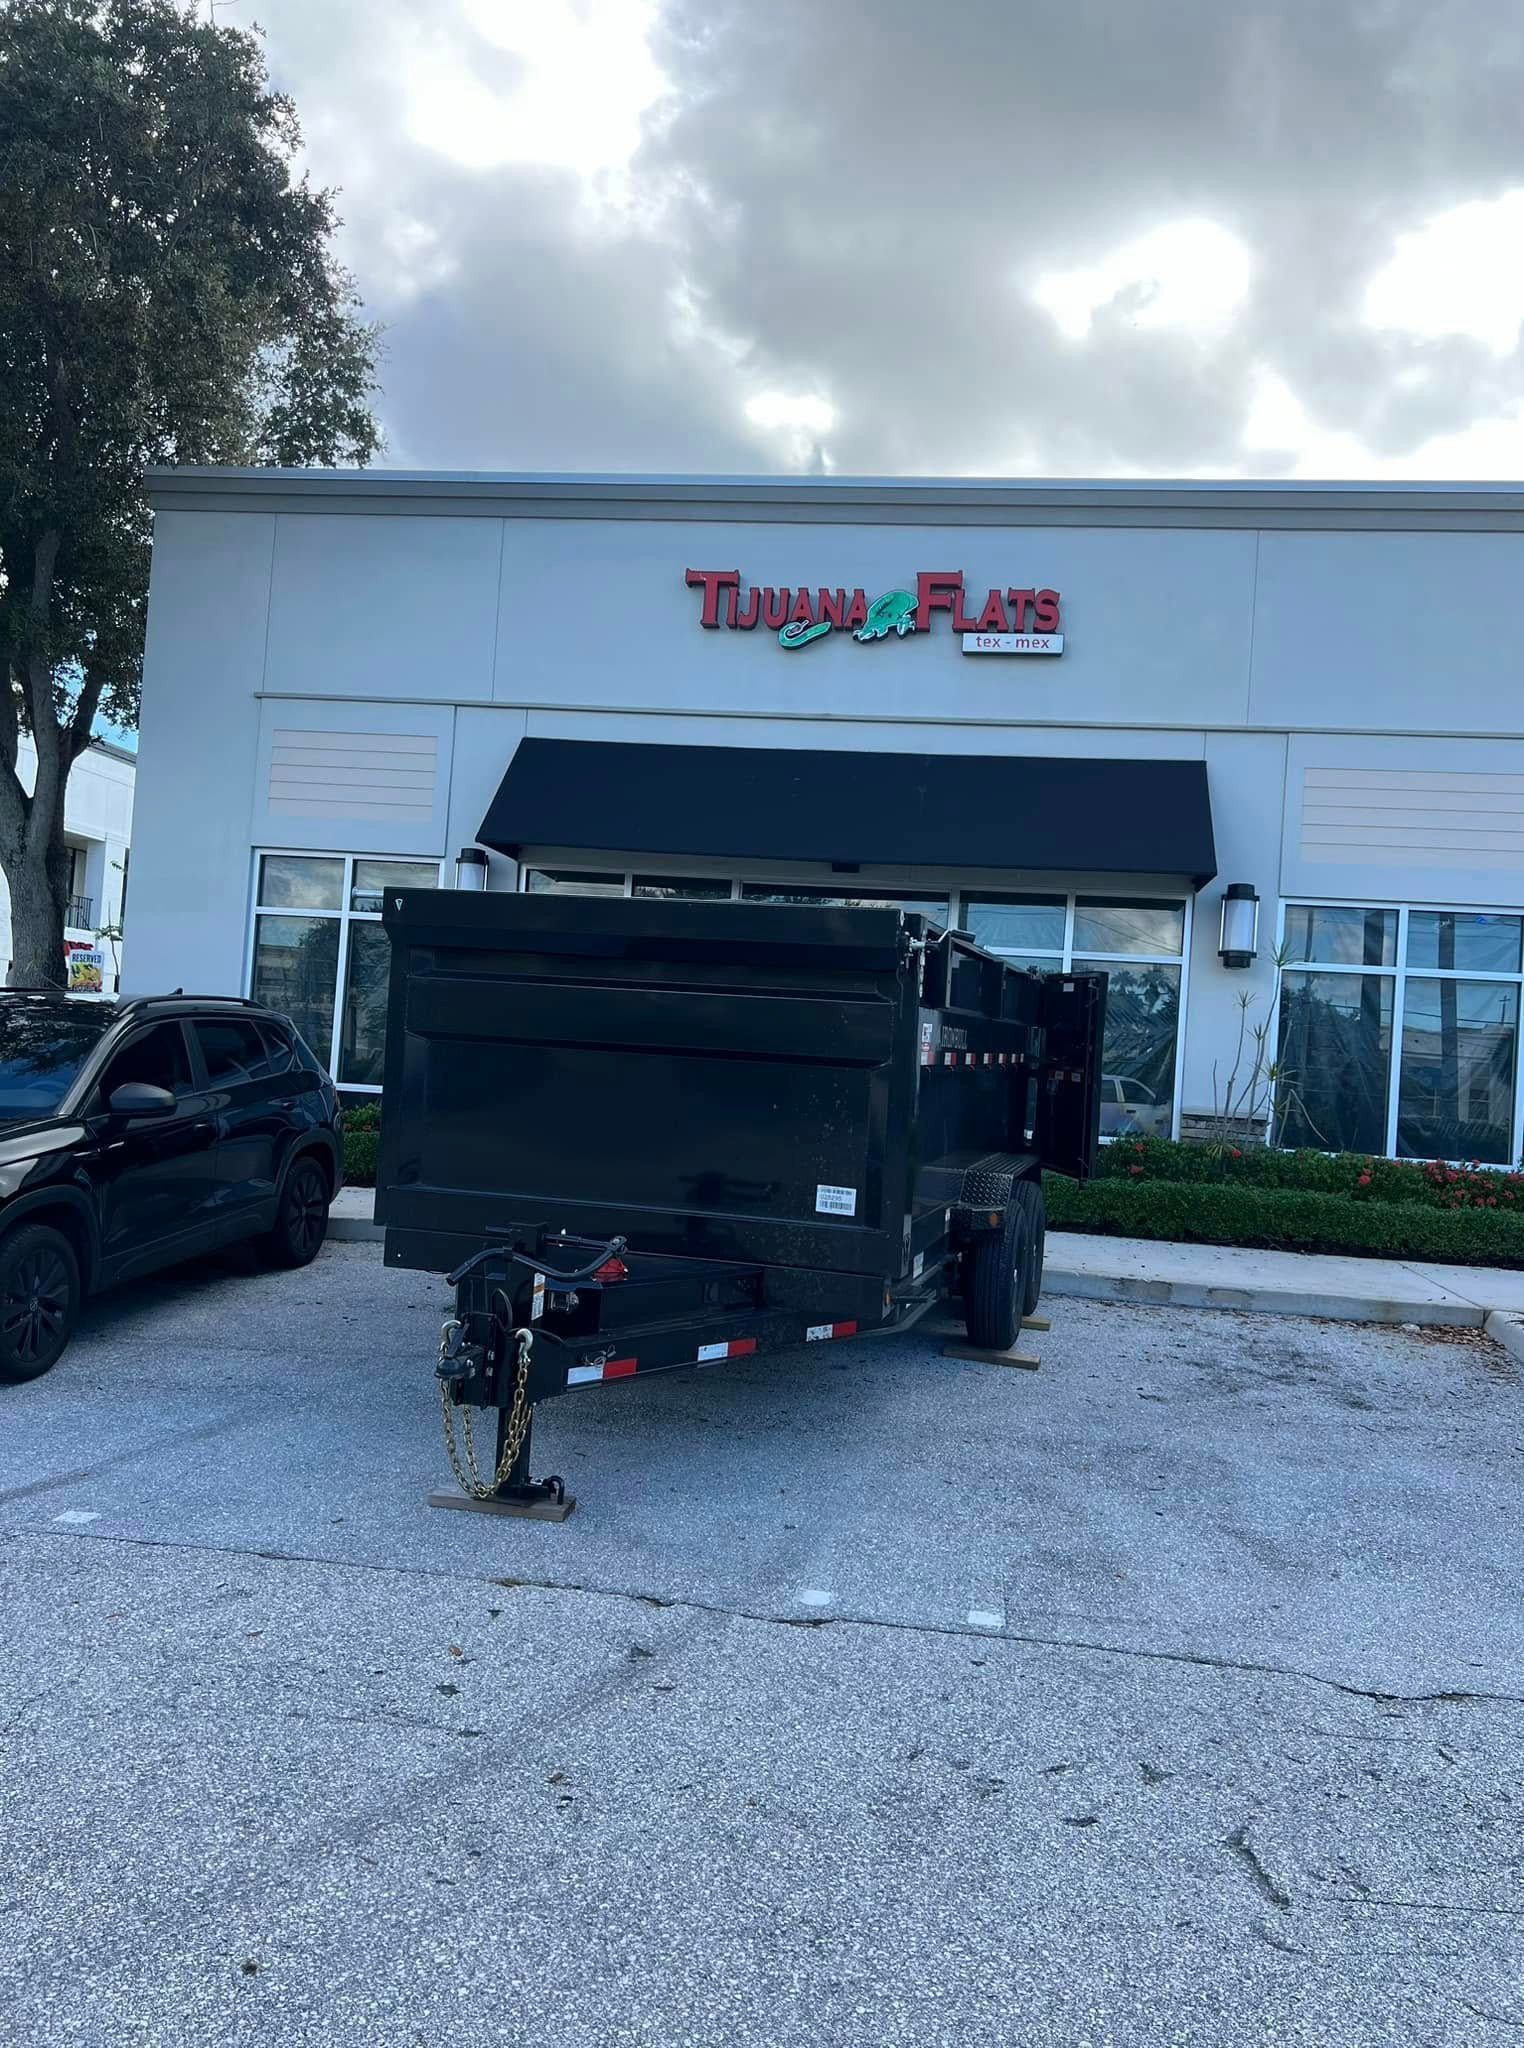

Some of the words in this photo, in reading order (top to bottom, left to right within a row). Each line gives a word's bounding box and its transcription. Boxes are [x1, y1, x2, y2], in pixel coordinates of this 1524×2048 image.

[686, 568, 867, 630] TIJUANA
[916, 570, 1061, 633] FLATS
[71, 953, 102, 963] RESERVED
